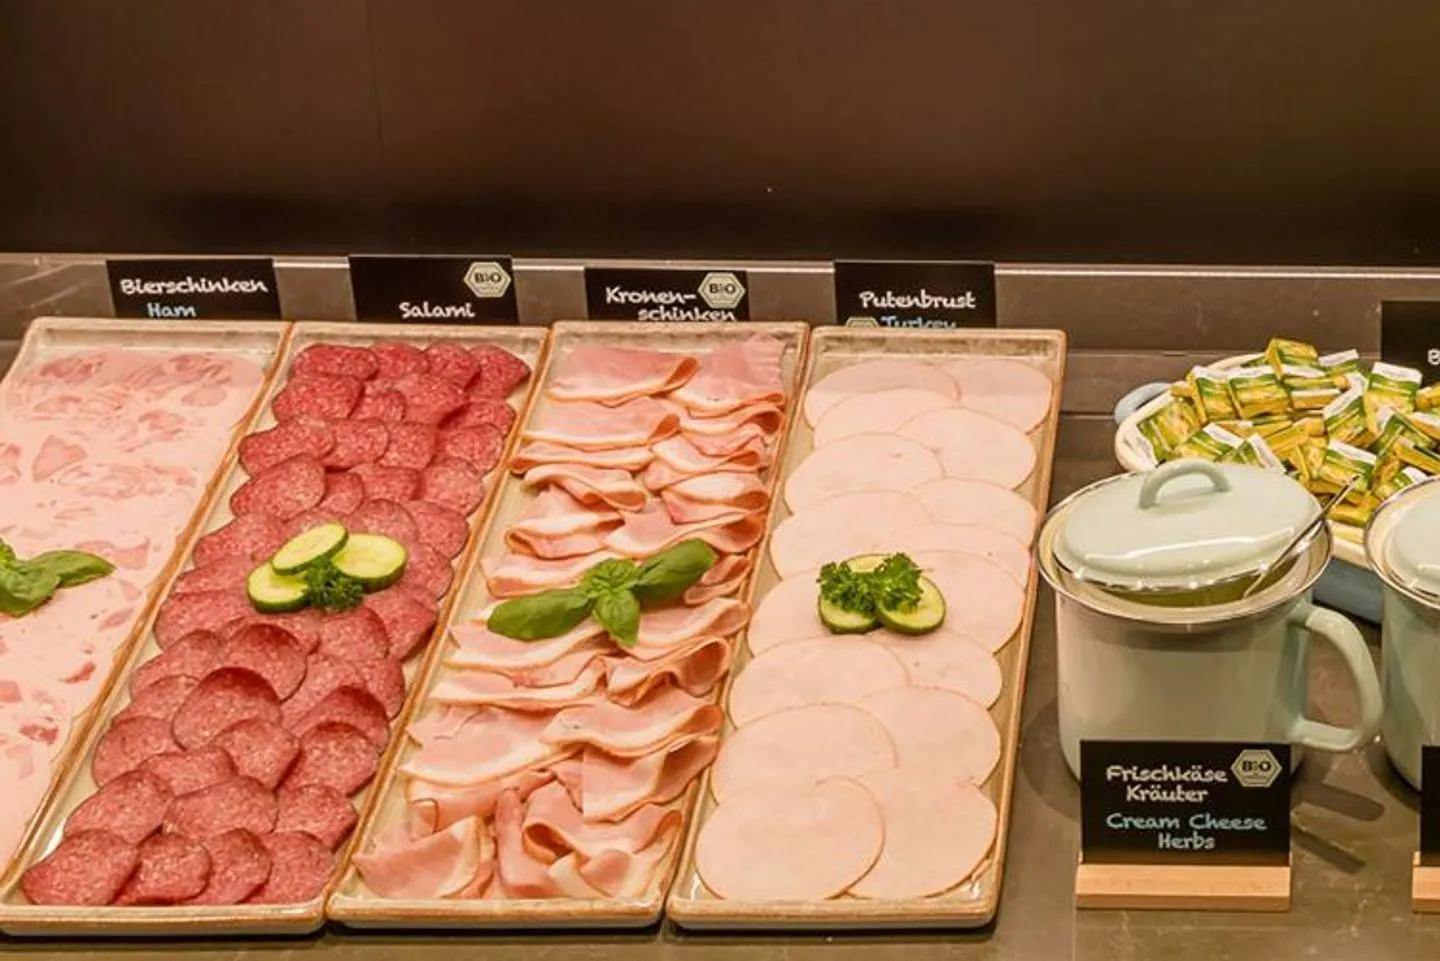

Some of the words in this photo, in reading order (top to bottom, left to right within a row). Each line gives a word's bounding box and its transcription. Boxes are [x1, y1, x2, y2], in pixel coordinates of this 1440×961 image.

[119, 276, 269, 295] Bierschinken
[605, 285, 697, 305] Kronen-
[858, 288, 977, 309] Putenbrust
[146, 302, 198, 318] Ham
[400, 302, 476, 319] Salami
[637, 305, 737, 321] schinken
[1106, 764, 1229, 783] Frischkäse
[1125, 784, 1209, 803] Kräuter
[1105, 812, 1180, 830] Cream
[1188, 813, 1268, 831] Cheese
[1157, 830, 1217, 851] Herbs
